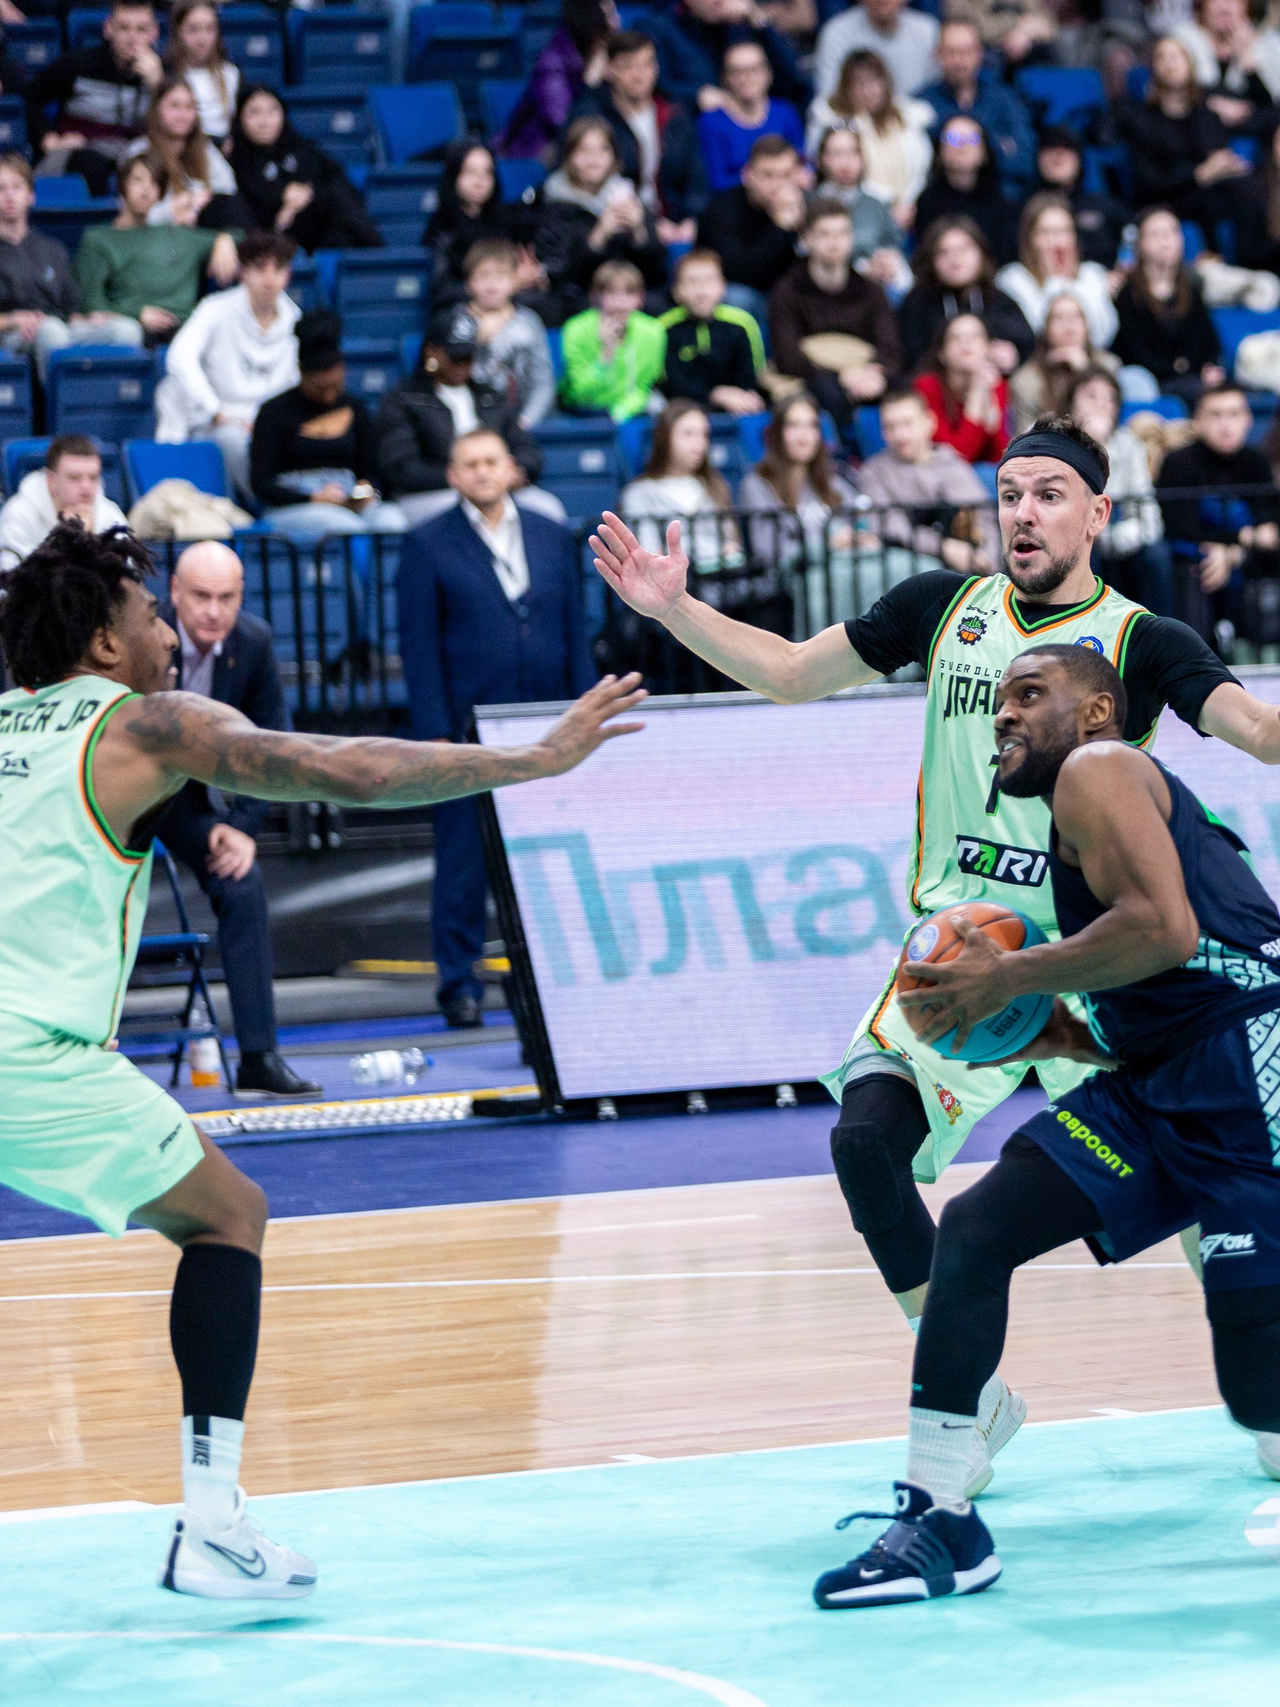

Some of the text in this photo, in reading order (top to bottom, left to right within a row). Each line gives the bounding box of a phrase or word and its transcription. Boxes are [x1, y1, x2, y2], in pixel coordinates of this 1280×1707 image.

[957, 840, 1046, 883] PARI
[992, 1006, 1023, 1037] FIBA
[1057, 1110, 1133, 1178] евроопт
